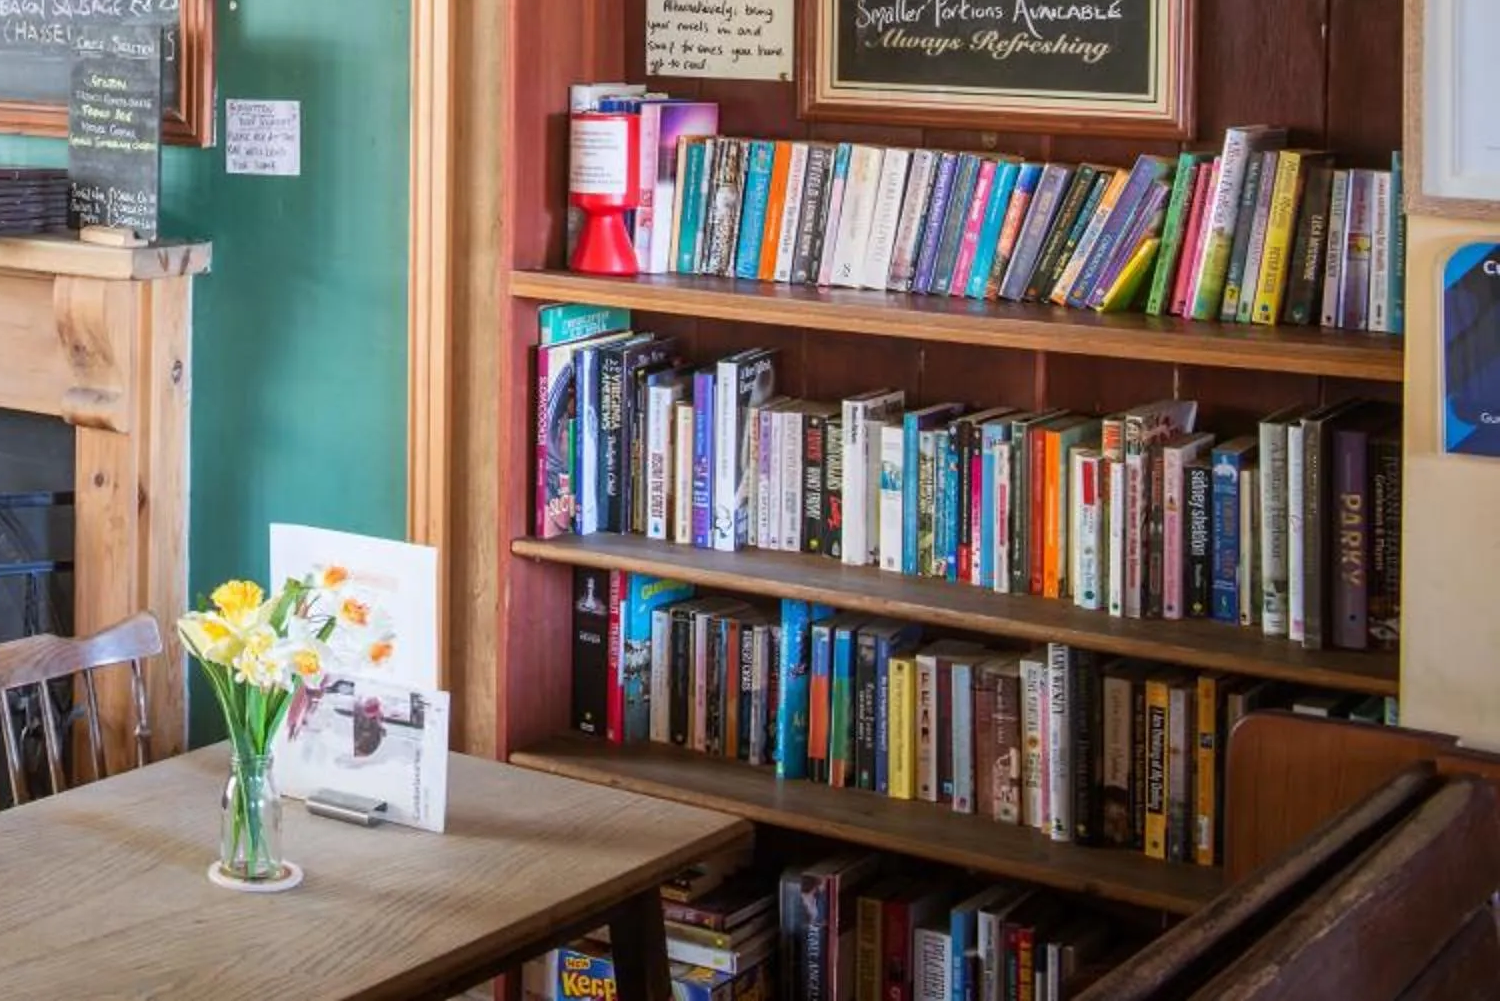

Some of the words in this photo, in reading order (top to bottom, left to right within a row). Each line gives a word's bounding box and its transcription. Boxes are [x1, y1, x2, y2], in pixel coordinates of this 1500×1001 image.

[745, 7, 774, 23] bring
[732, 46, 753, 62] you
[865, 28, 964, 57] Always
[969, 29, 1112, 64] Refreshing
[1188, 470, 1206, 509] sidney
[1191, 510, 1206, 556] sheldon
[1340, 493, 1362, 587] PARKY
